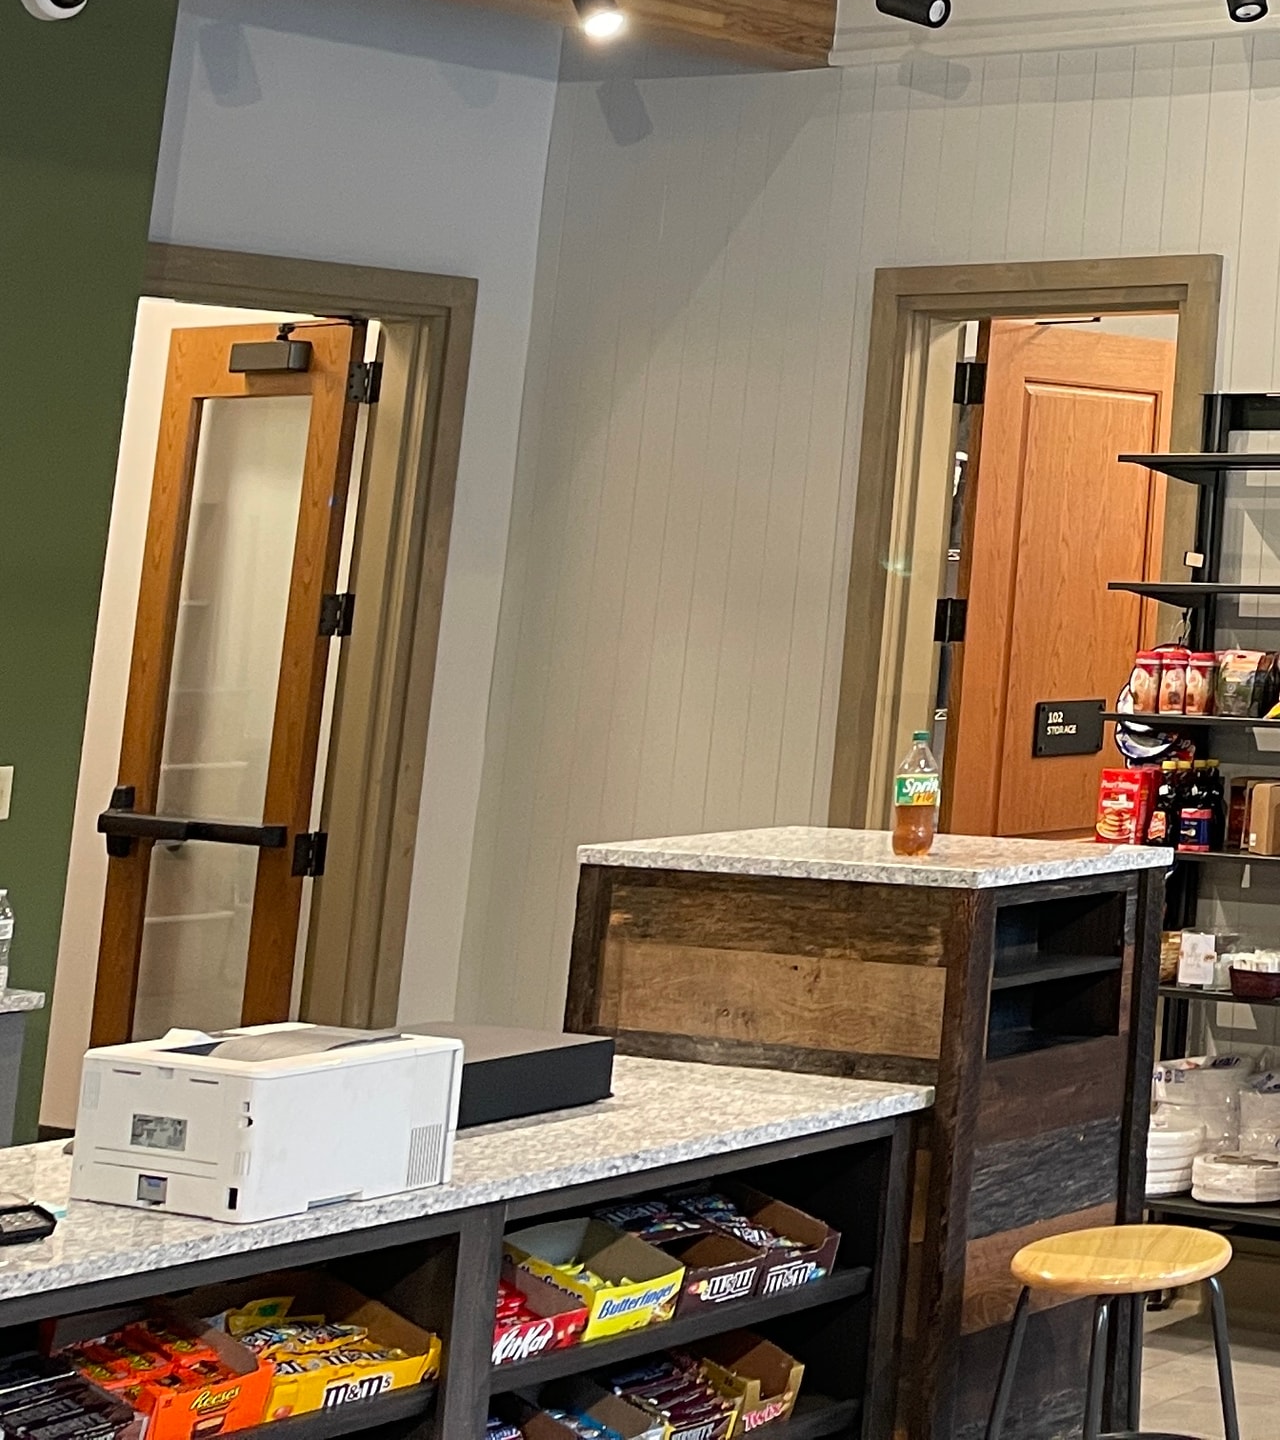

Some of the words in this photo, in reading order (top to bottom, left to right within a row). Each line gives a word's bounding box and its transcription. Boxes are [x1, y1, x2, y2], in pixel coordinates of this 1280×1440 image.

[1047, 711, 1063, 724] 102
[1046, 724, 1077, 736] STORAGE
[597, 1283, 676, 1320] Butterfinger
[742, 1401, 783, 1432] Twix
